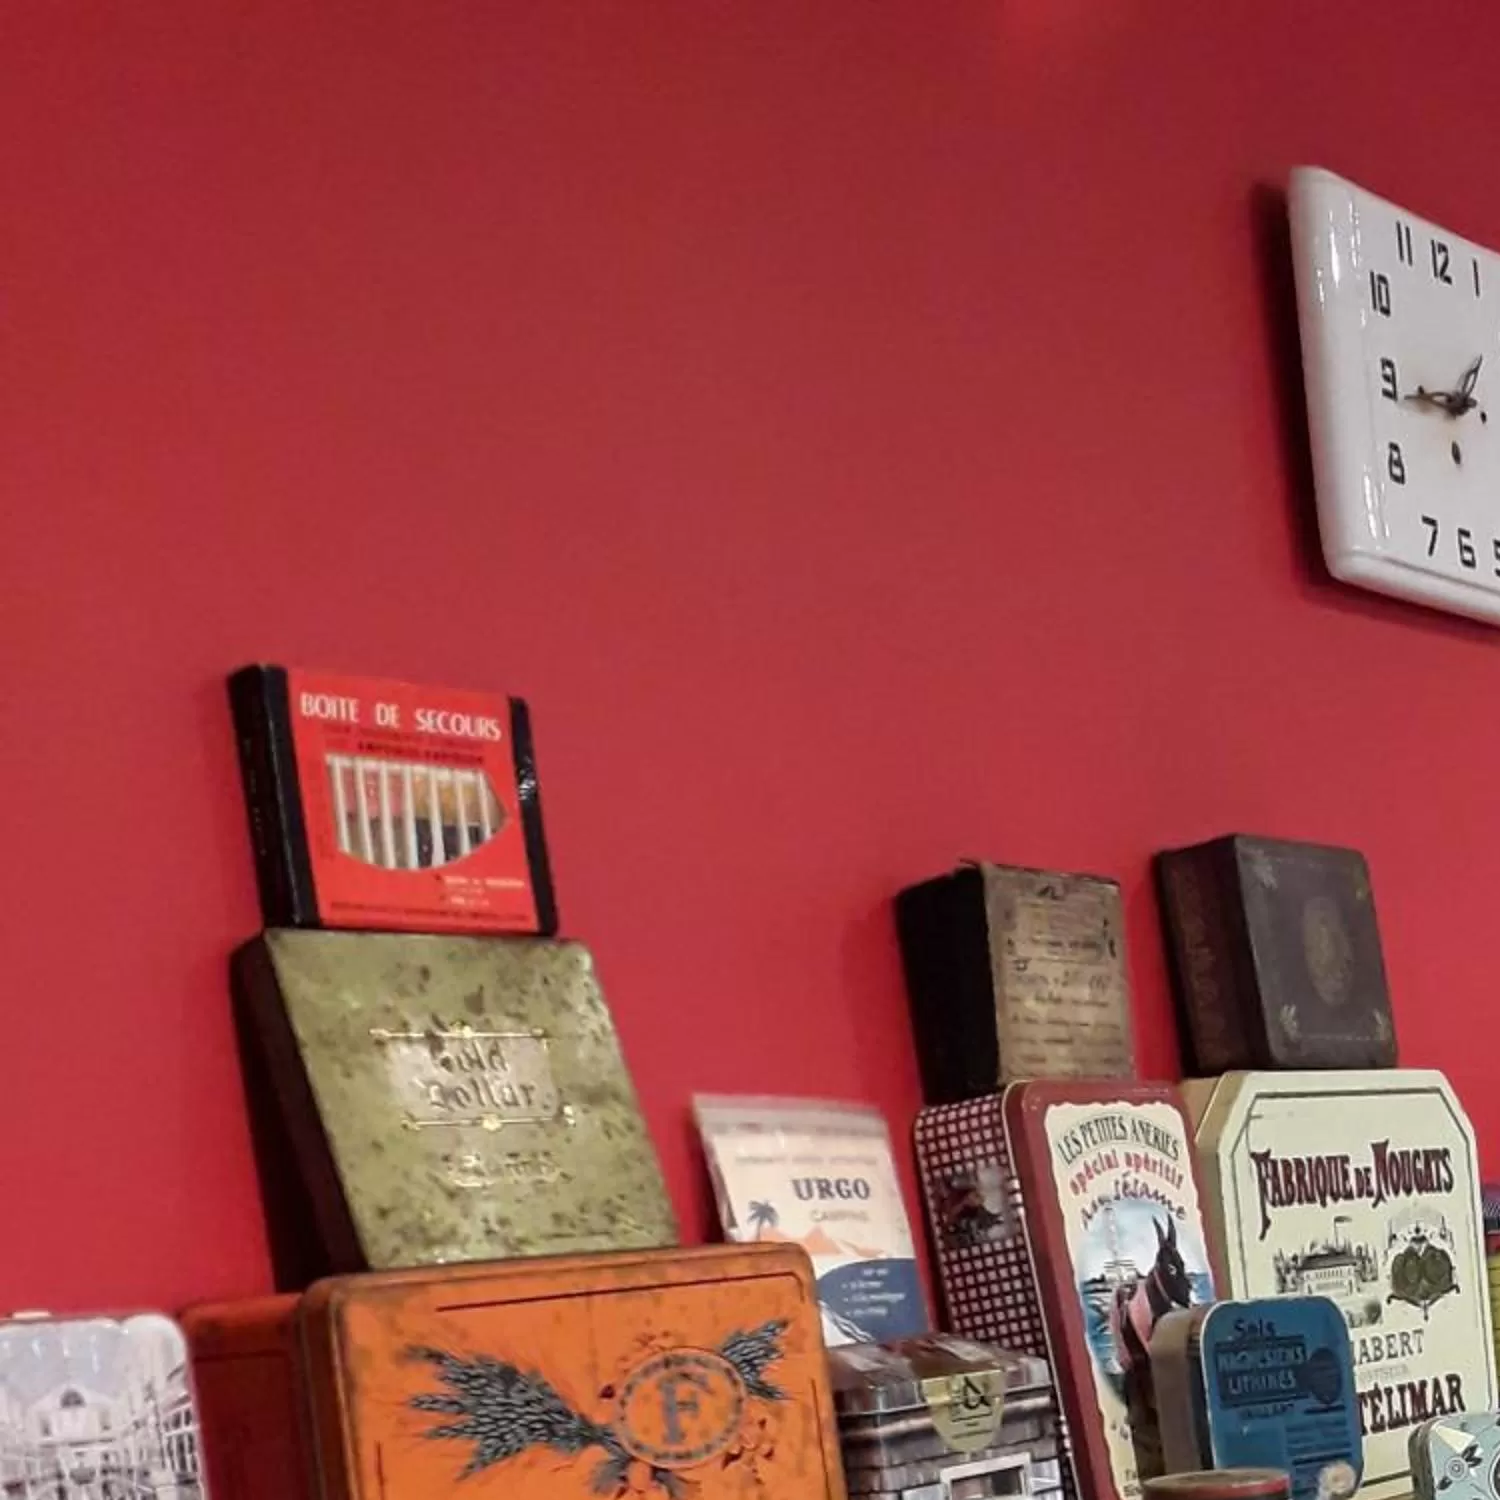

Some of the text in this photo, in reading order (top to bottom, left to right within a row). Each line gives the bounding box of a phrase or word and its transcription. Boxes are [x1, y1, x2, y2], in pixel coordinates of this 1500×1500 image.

[1396, 221, 1412, 266] 11
[1431, 240, 1452, 285] 12
[1370, 271, 1391, 316] 10
[1473, 260, 1480, 297] 1
[1381, 358, 1398, 401] 9
[1388, 442, 1405, 484] 8
[1421, 515, 1438, 556] 7
[1457, 528, 1475, 568] 6
[301, 692, 502, 741] BOITE DE SECOURS
[1058, 1129, 1083, 1165] LES
[1079, 1115, 1128, 1150] PETITES
[790, 1177, 870, 1200] URGO
[1250, 1138, 1454, 1240] FABRIQUE DE NOUGATS
[1354, 1328, 1424, 1366] ABERT
[1357, 1373, 1466, 1435] TÉLIMAR
